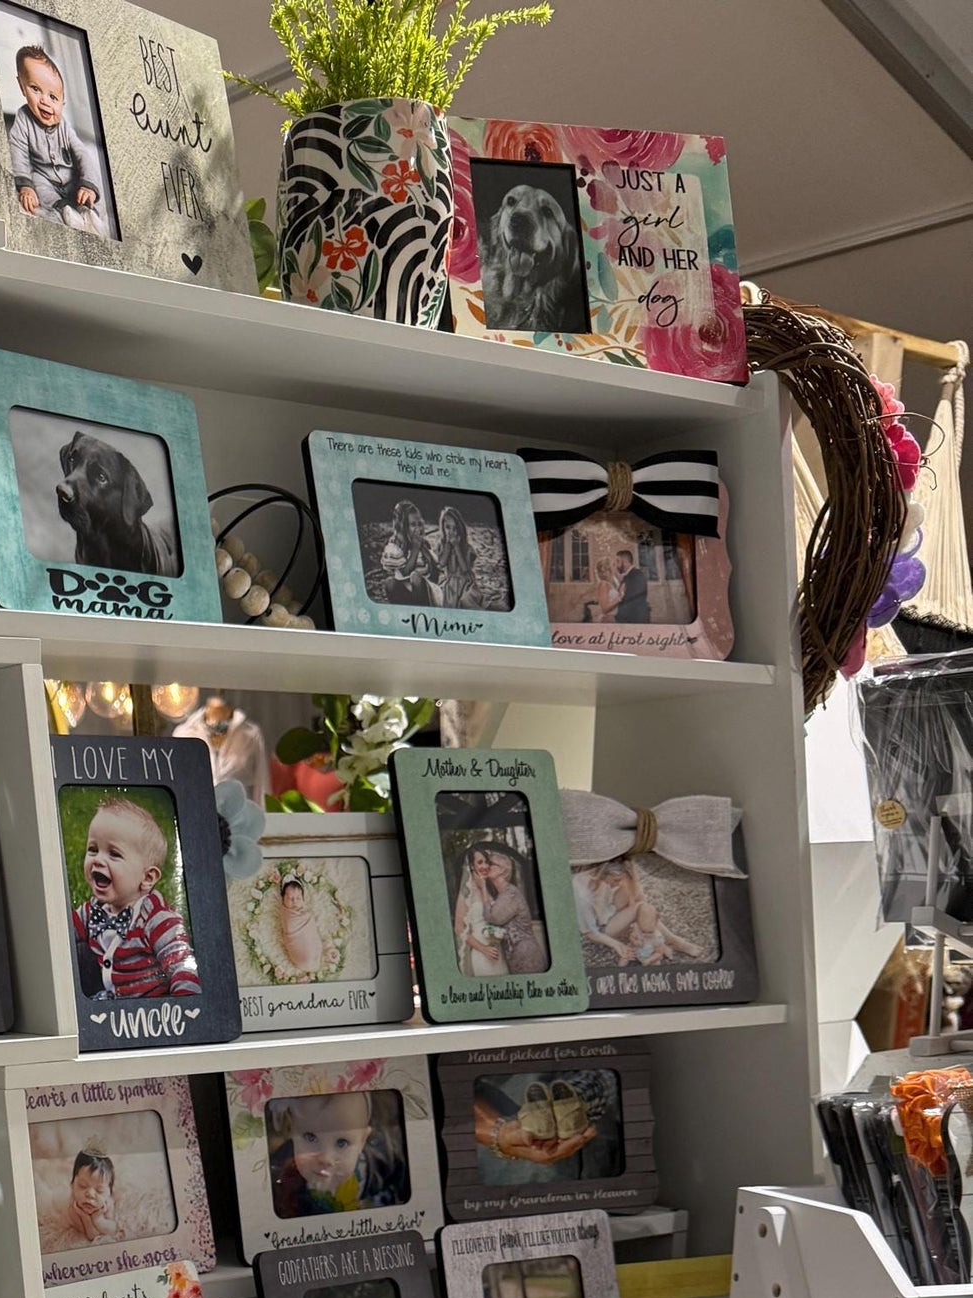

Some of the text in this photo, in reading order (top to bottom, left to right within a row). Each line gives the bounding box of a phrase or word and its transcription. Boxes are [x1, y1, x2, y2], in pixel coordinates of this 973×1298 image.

[138, 35, 181, 97] BEST
[160, 161, 204, 222] EVER
[616, 169, 686, 194] JUST A
[617, 205, 684, 246] girl
[617, 246, 699, 271] AND HER
[637, 281, 684, 327] dog
[326, 437, 354, 453] There
[357, 443, 374, 455] are
[376, 443, 402, 458] these
[404, 446, 423, 460] kids
[425, 450, 442, 463] who
[445, 452, 466, 466] stole
[469, 458, 482, 472] my
[397, 460, 450, 480] they call me
[52, 595, 174, 620] mama
[411, 613, 478, 638] Mimi
[588, 631, 606, 645] at
[607, 630, 645, 650] first
[646, 632, 687, 651] sight
[51, 745, 176, 781] I LOVE MY
[421, 758, 536, 787] Mother & Daughter
[241, 990, 370, 1018] BEST grandma EVER
[110, 1002, 186, 1040] uncle
[467, 1044, 617, 1065] Hand picked for Earth
[82, 1081, 115, 1103] little
[117, 1077, 165, 1105] sparkle
[509, 1192, 571, 1208] Grandma
[592, 1188, 638, 1200] Heaven
[116, 1250, 141, 1270] she
[278, 1242, 415, 1286] GODFATHERS ARE A BLESSING
